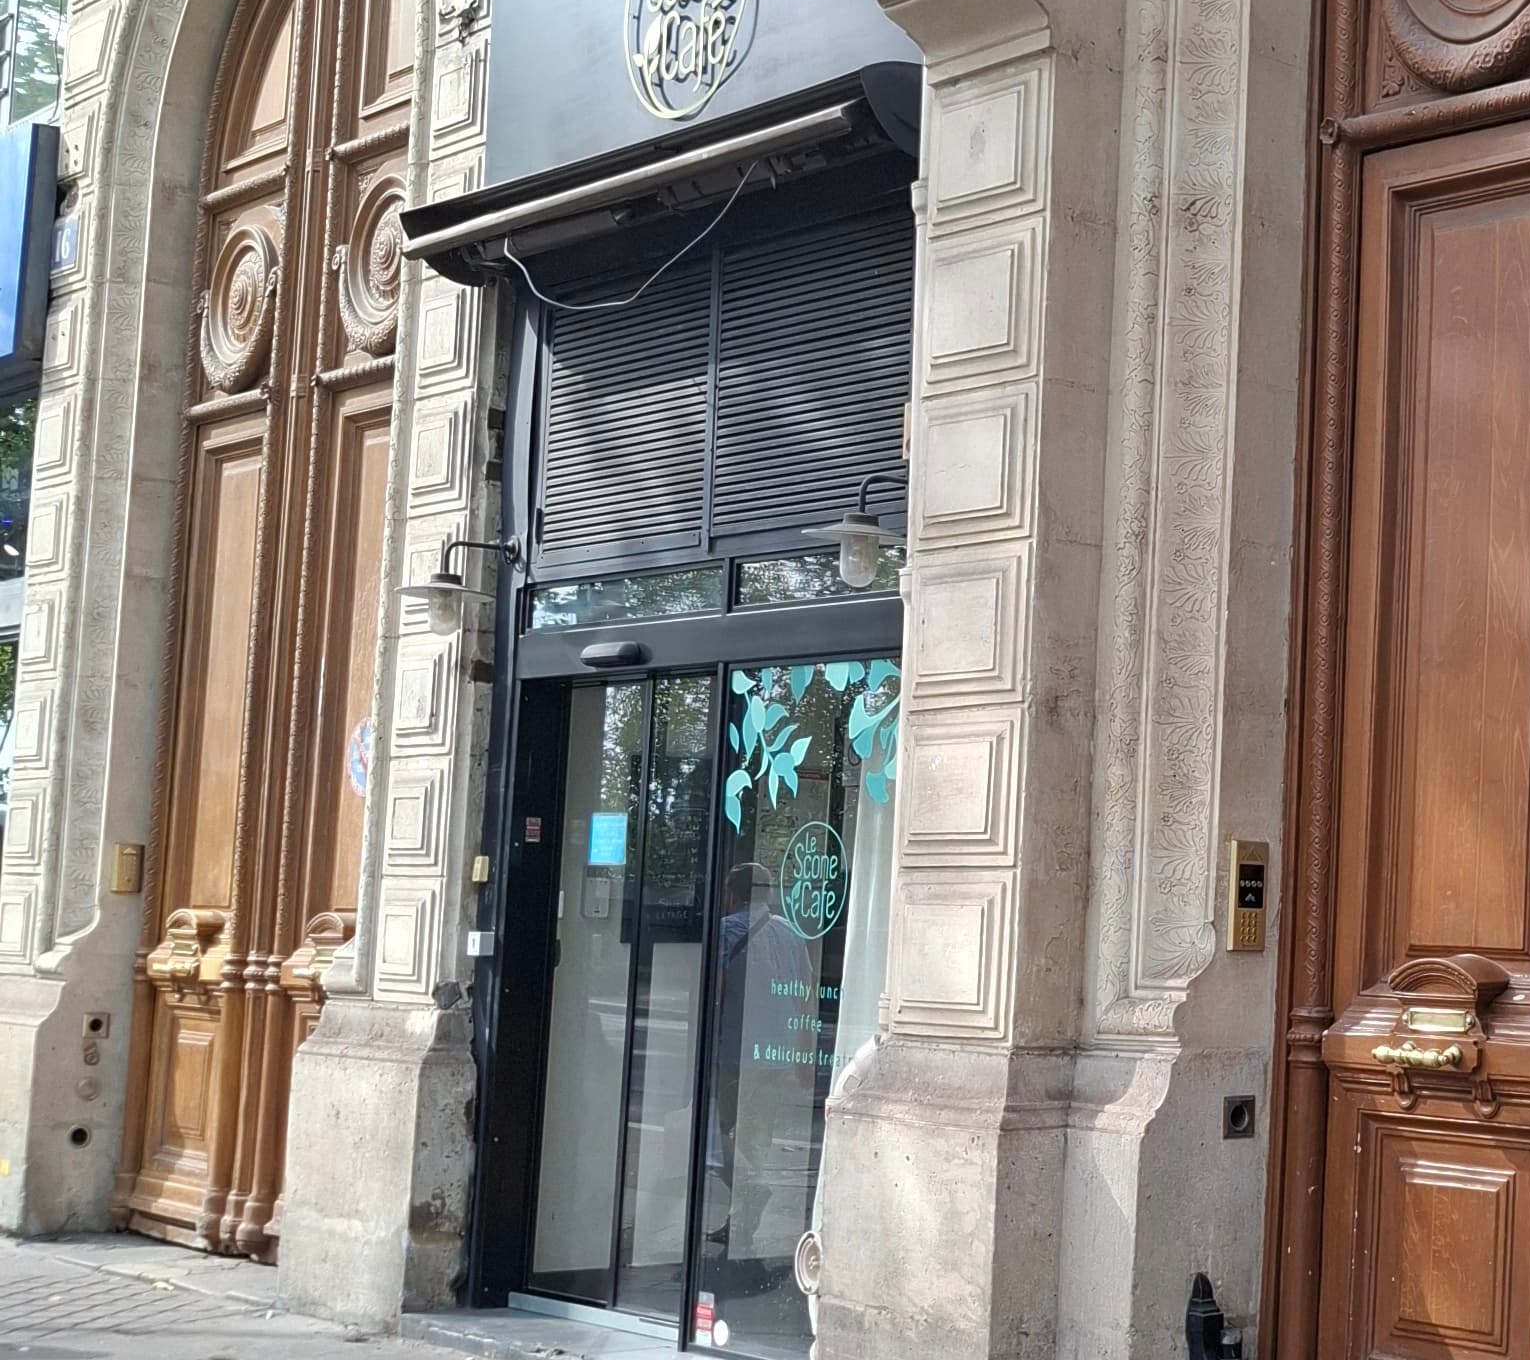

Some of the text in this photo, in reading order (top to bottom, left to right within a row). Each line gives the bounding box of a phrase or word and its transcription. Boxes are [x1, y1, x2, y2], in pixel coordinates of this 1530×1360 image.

[55, 228, 71, 262] 16
[805, 831, 817, 854] Le
[793, 842, 838, 880] Scone
[770, 978, 811, 1002] healthy
[787, 1014, 822, 1033] coffee
[753, 1043, 761, 1061] &
[765, 1043, 814, 1065] delicious
